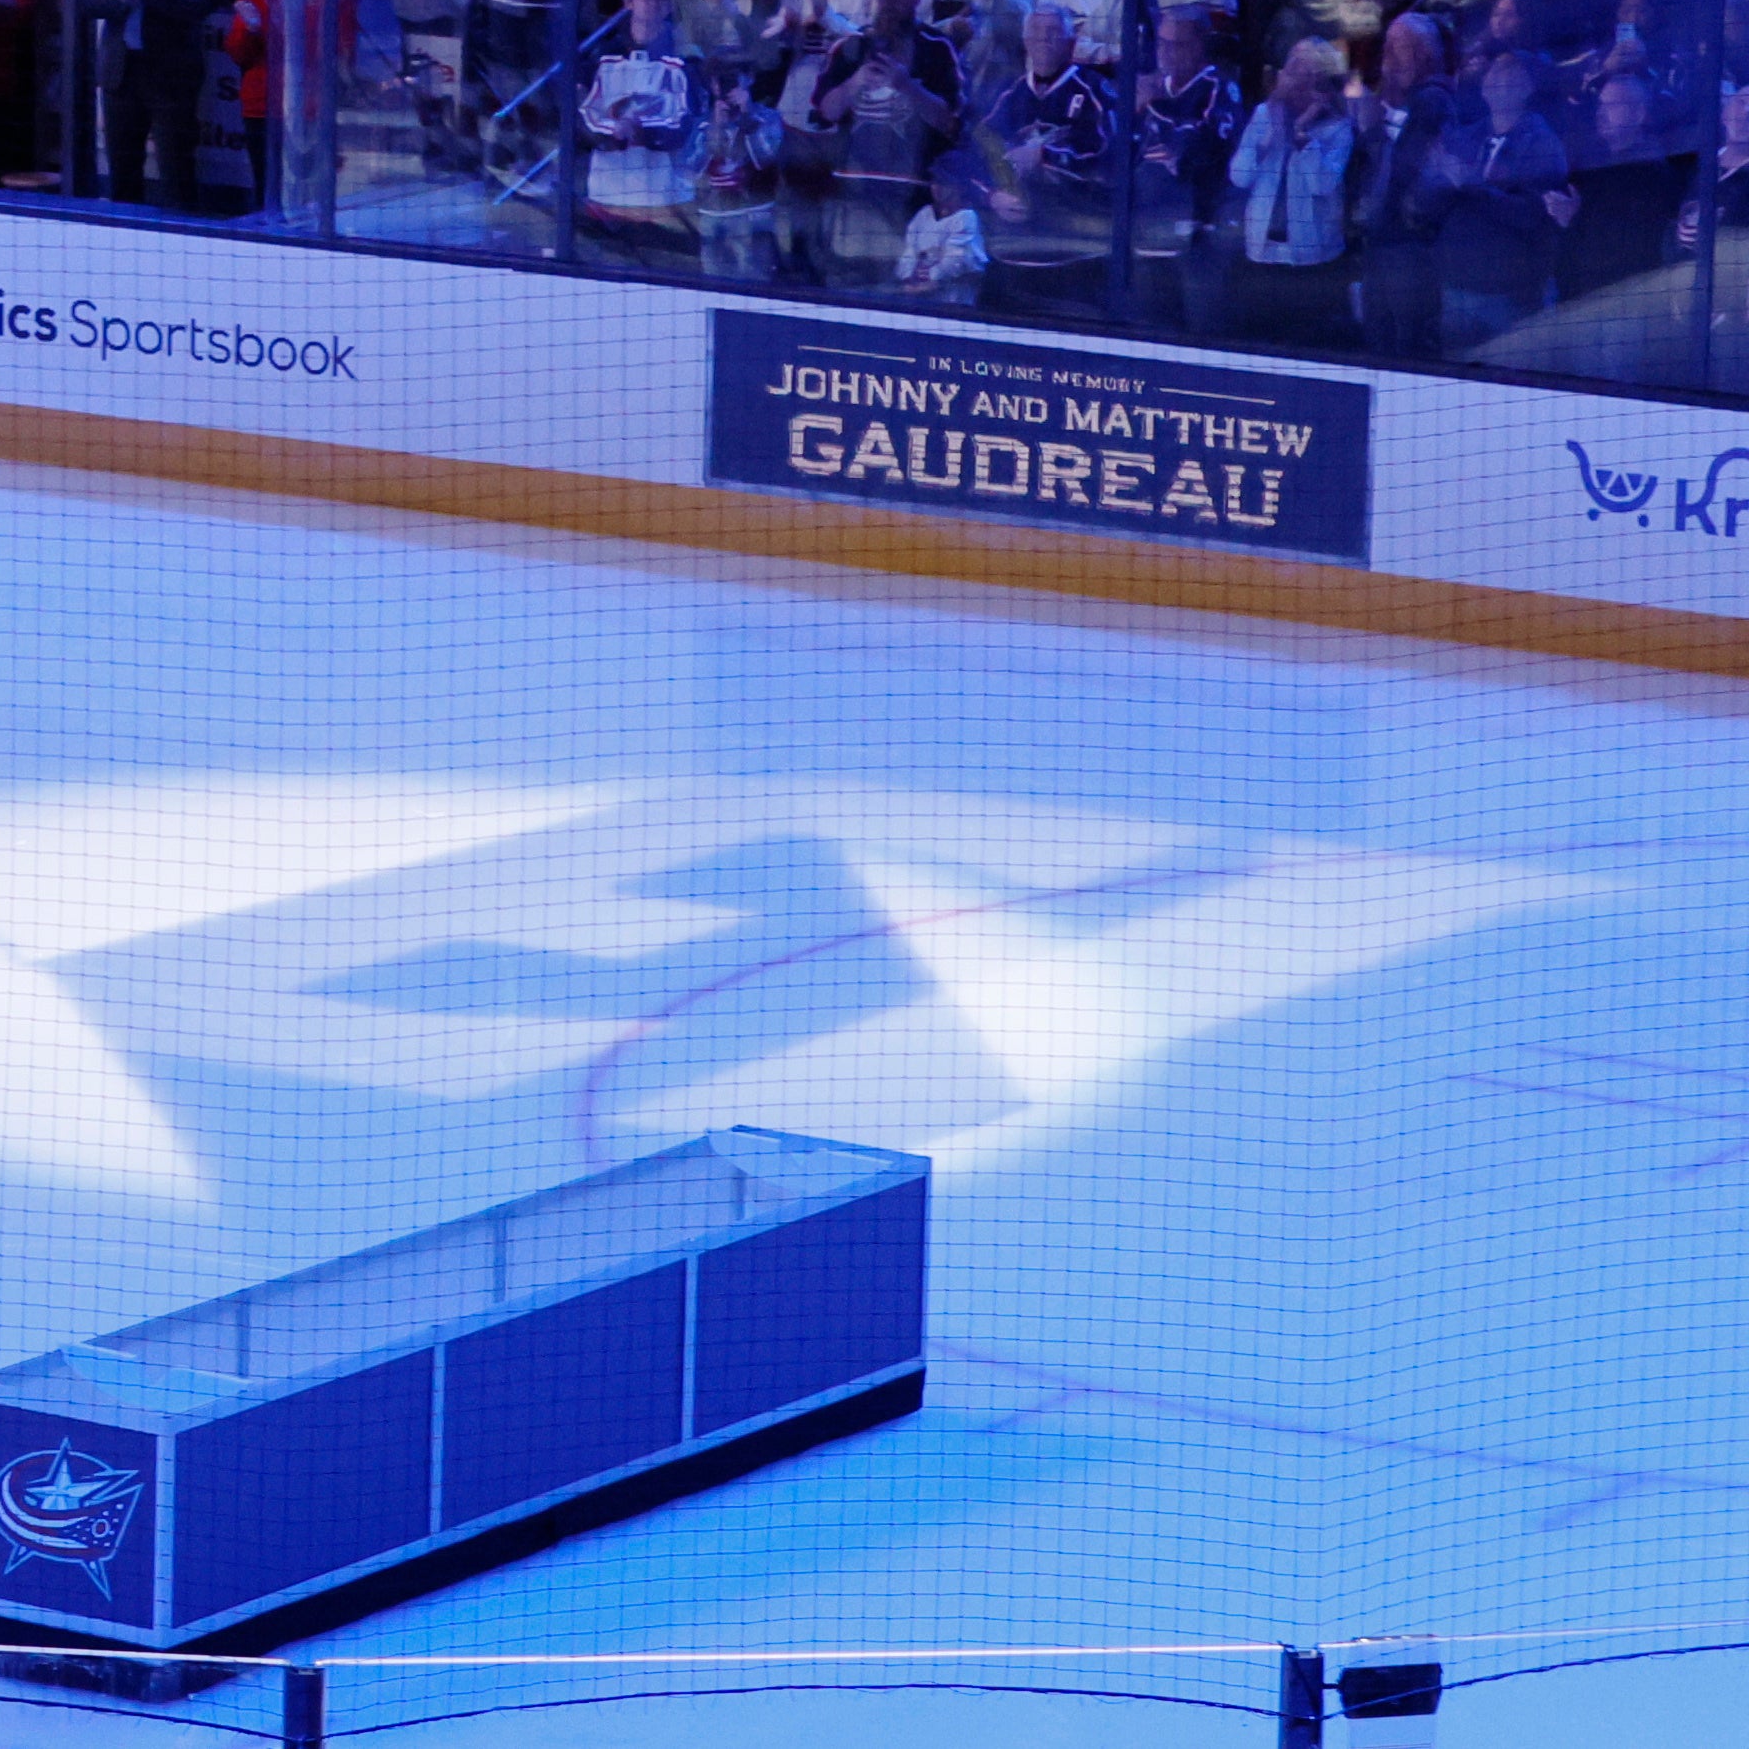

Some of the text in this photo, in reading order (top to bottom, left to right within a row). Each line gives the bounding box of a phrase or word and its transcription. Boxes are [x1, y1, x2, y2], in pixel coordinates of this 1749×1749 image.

[69, 300, 356, 380] Sportsbook
[929, 356, 952, 372] IN
[765, 363, 1313, 459] JOHNNY AND MATTHEW
[787, 413, 1284, 529] GAUDREAU
